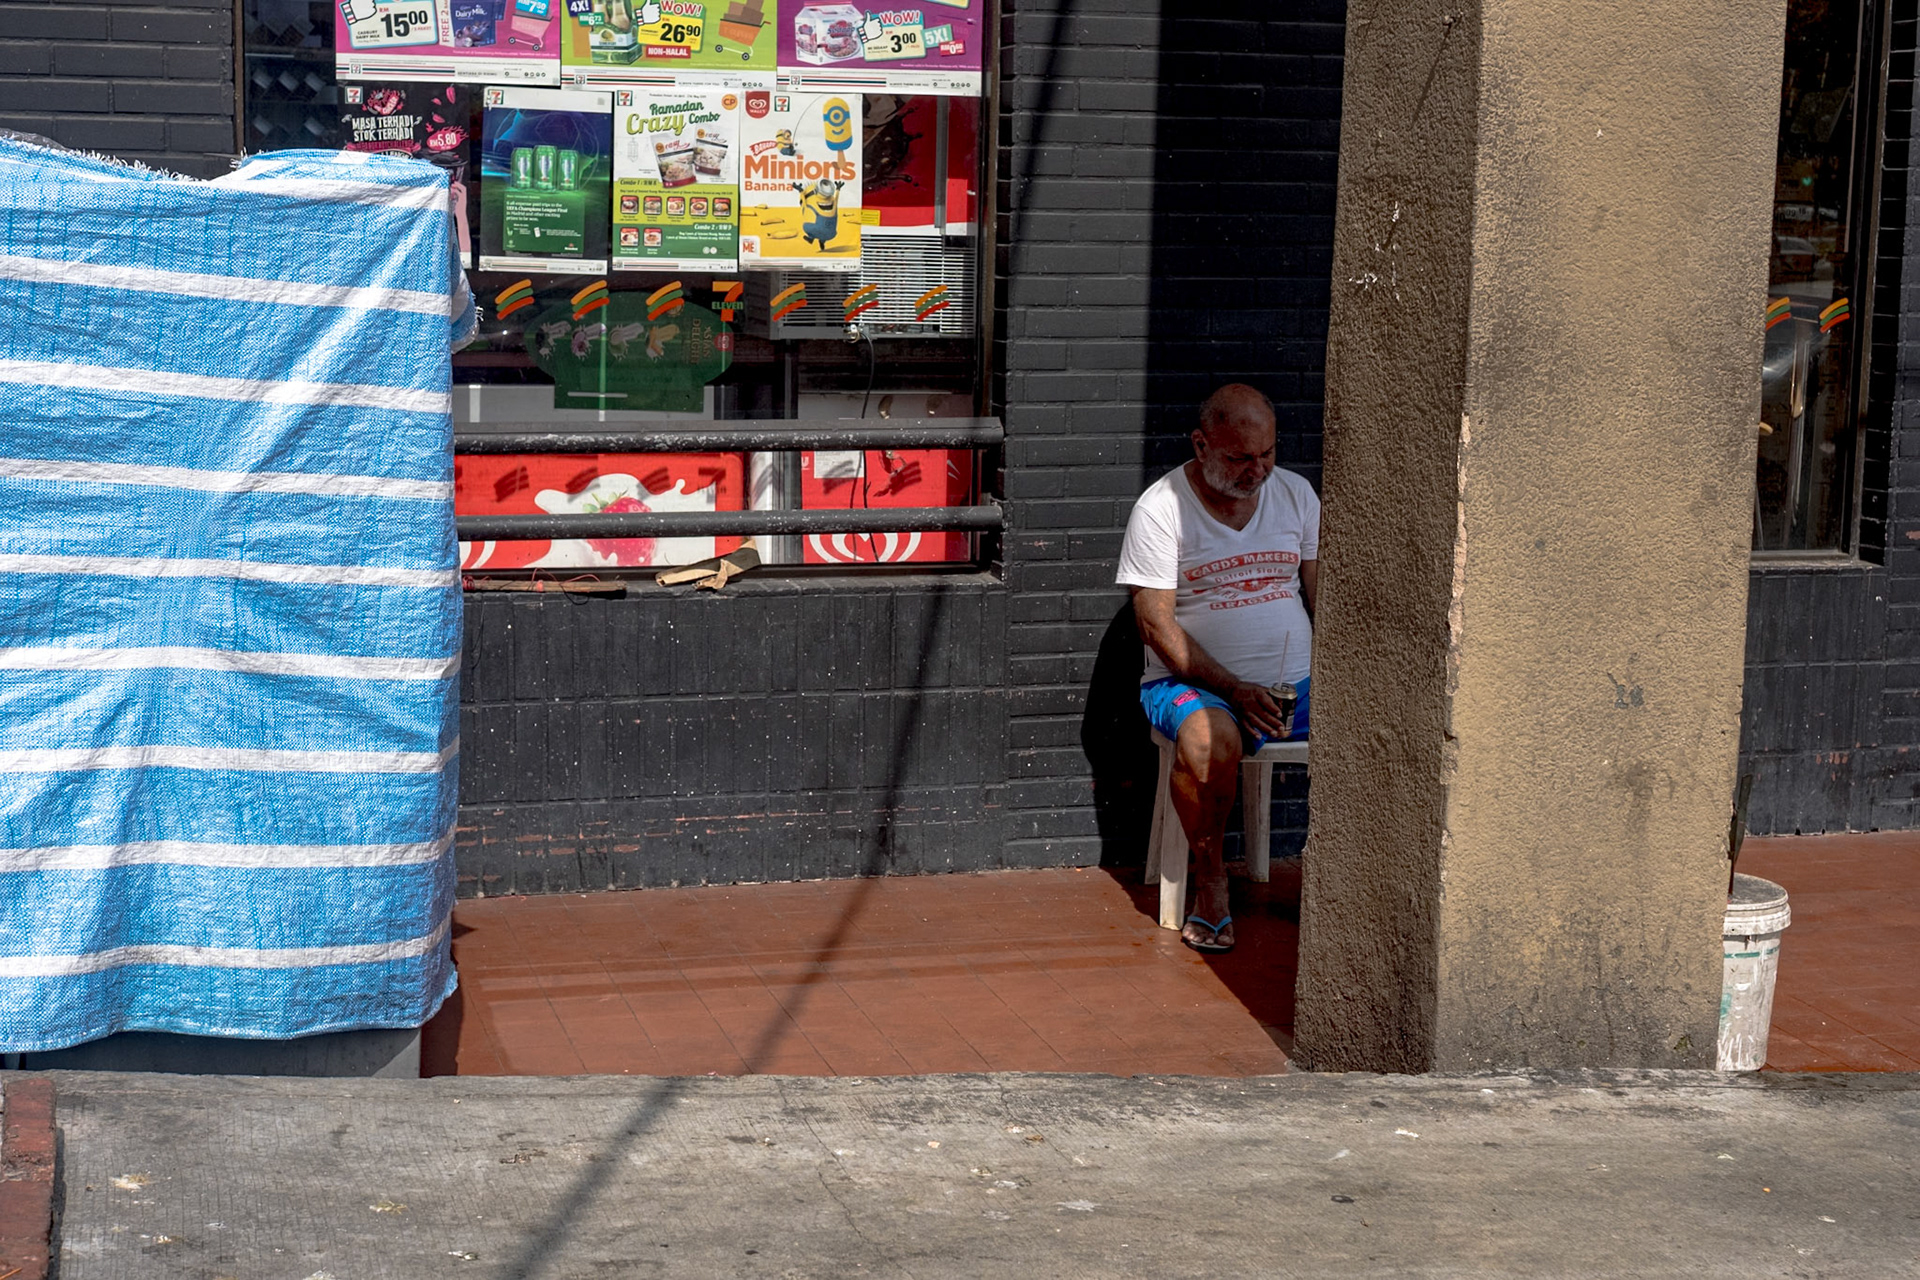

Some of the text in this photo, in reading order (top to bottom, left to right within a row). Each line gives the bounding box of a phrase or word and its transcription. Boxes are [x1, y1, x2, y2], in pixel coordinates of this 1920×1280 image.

[456, 10, 471, 18] Dairy
[660, 0, 702, 16] WOW!
[880, 10, 920, 25] WOW!
[442, 18, 450, 42] FREE
[924, 28, 948, 45] 5X!
[648, 48, 688, 56] NON-HALAL
[650, 101, 704, 115] Ramadan
[352, 117, 376, 130] MASA
[626, 112, 720, 136] Crazy Combo
[354, 128, 378, 142] STOK
[744, 154, 856, 180] Minions
[744, 181, 794, 192] Banana
[712, 281, 744, 322] 7
[1243, 552, 1296, 564] MAKERS
